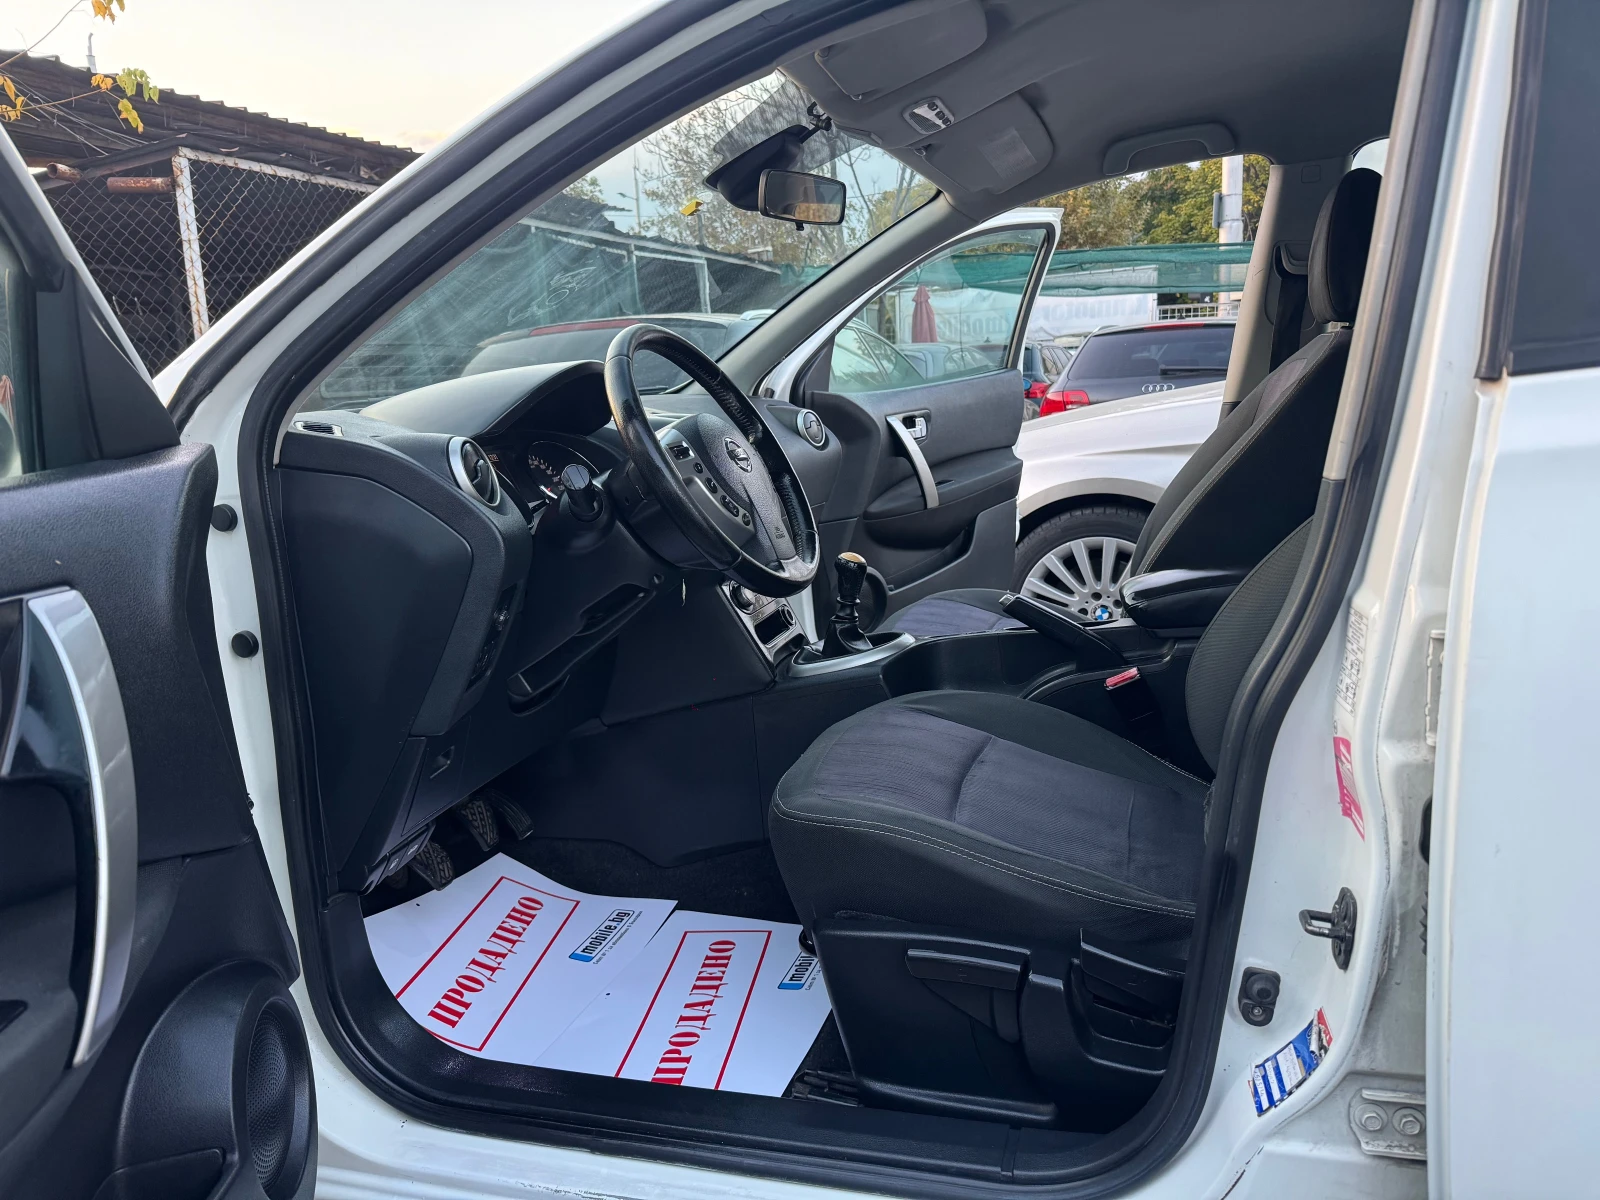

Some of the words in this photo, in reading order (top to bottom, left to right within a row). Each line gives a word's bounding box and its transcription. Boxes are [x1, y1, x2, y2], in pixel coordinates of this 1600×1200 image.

[428, 897, 544, 1028] ПРОДАДЕНО
[580, 911, 631, 955] mobile.bg
[788, 955, 815, 982] mobil
[650, 940, 737, 1086] ПРОДАДЕНО
